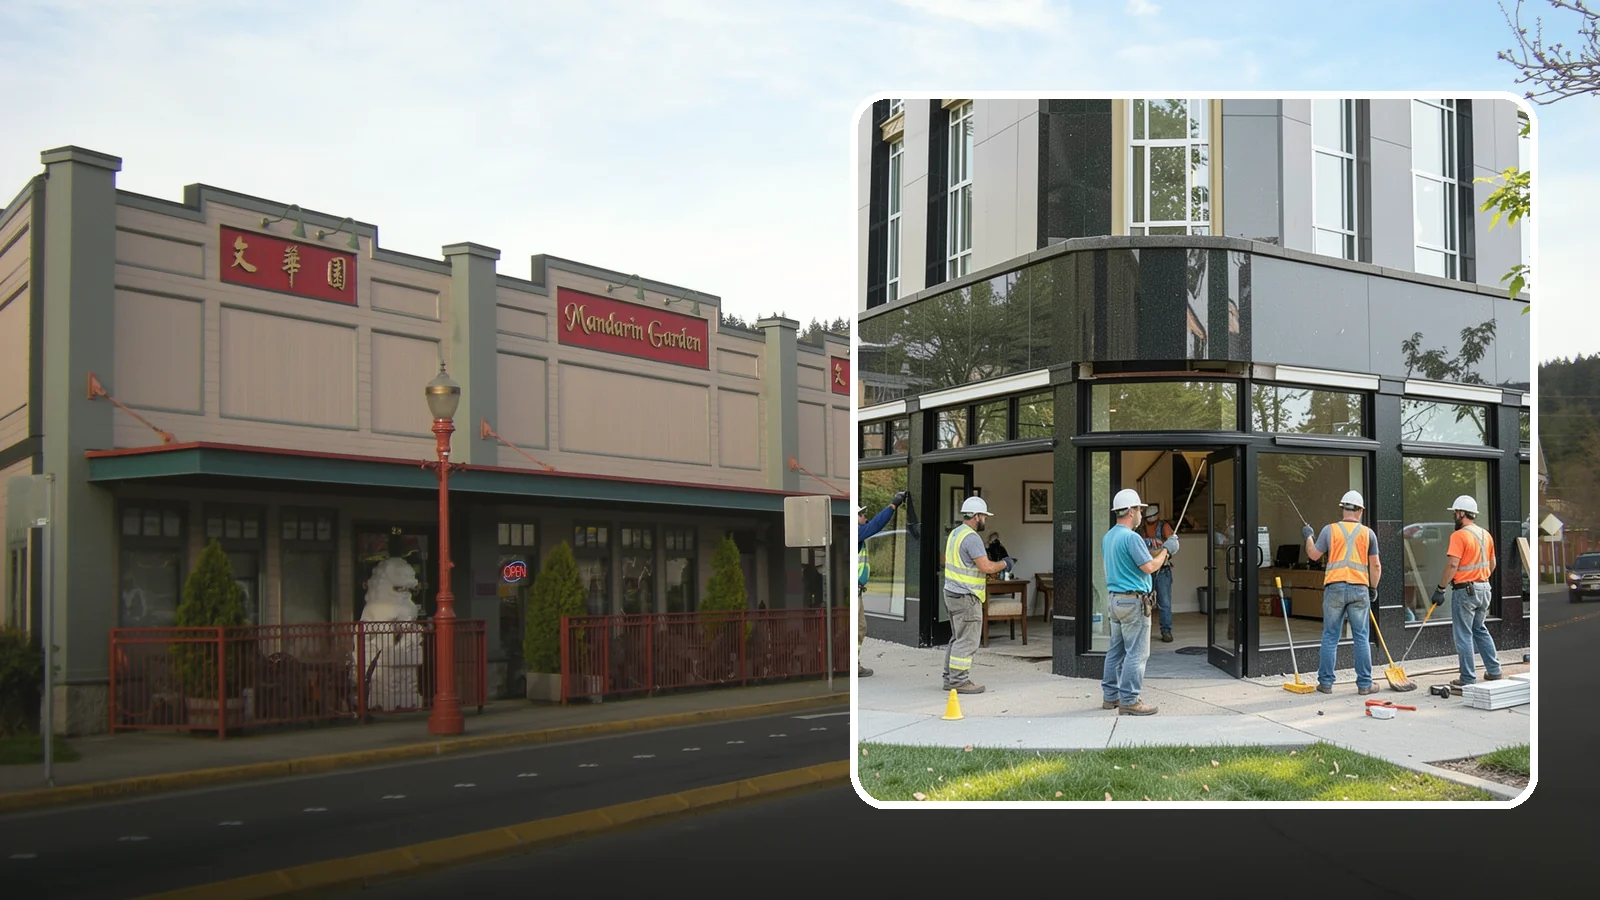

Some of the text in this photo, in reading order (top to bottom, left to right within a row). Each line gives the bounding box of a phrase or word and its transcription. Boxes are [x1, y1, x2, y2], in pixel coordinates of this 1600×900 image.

[231, 236, 346, 290] 文華園
[565, 302, 701, 352] Mandarin Garden
[503, 565, 527, 578] OPEN
